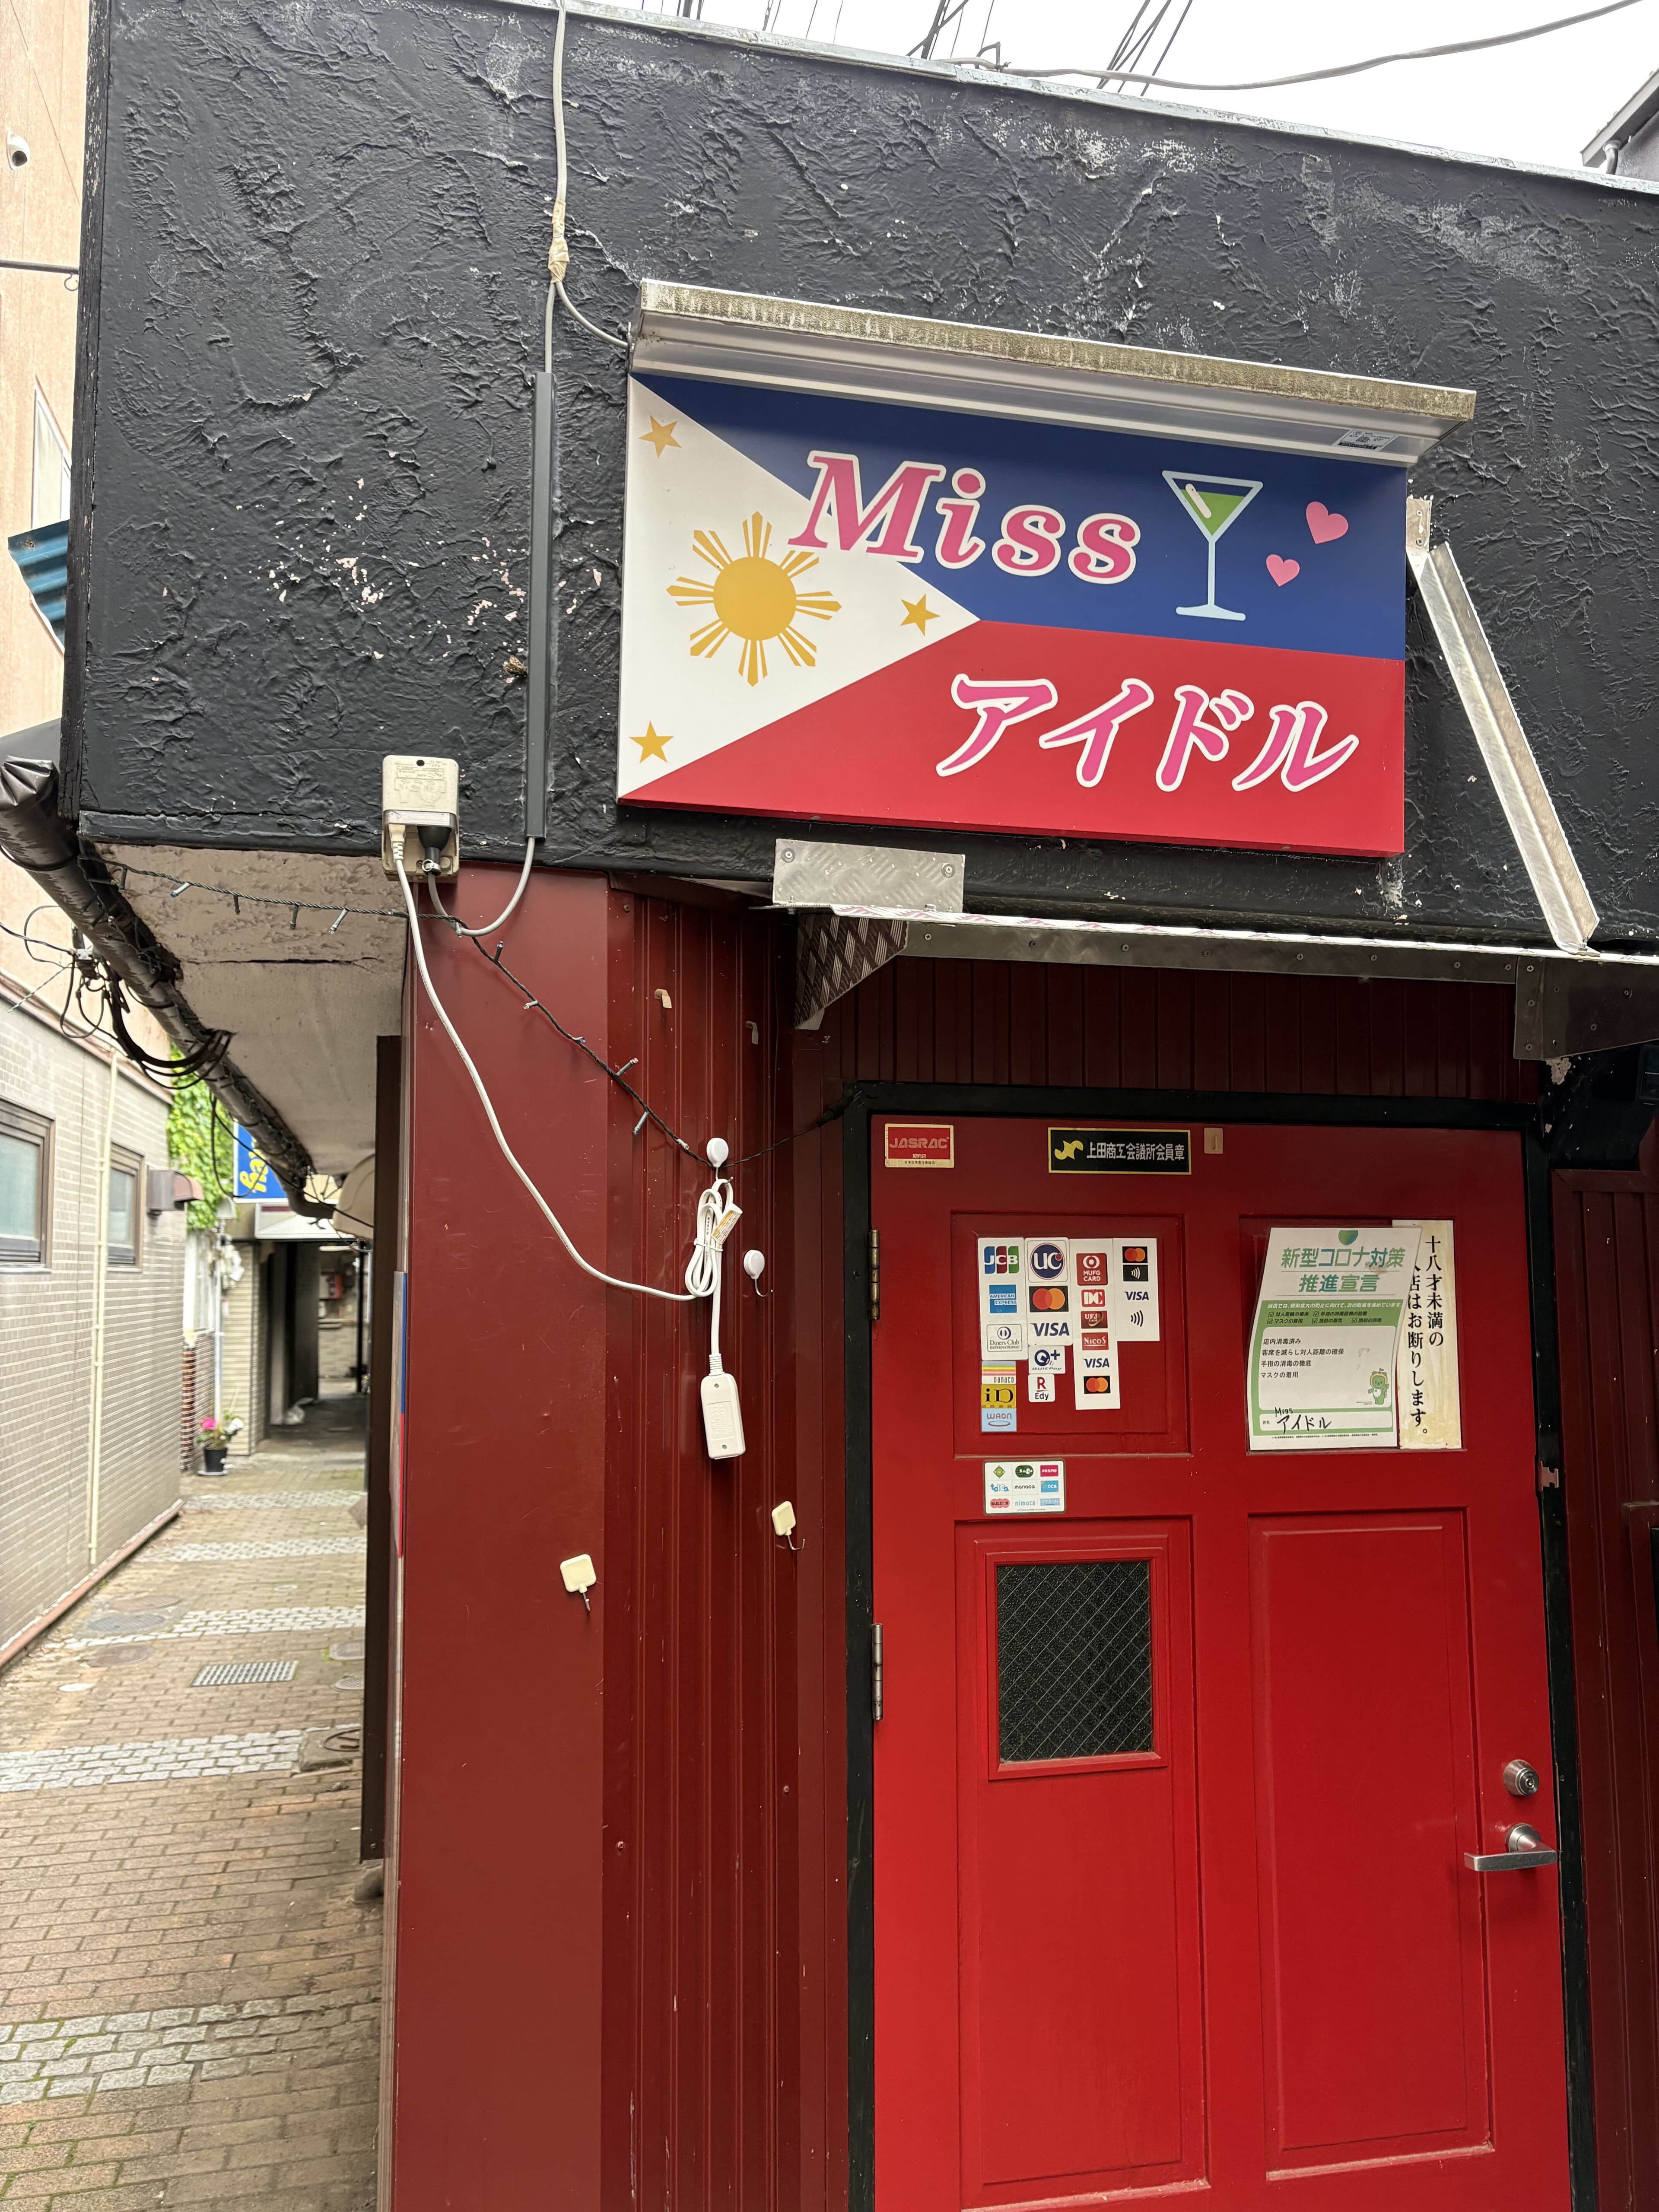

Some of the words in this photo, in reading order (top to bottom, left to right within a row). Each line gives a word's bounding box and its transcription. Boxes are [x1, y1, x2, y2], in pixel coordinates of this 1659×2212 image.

[785, 450, 1141, 584] Miss
[936, 674, 1358, 792] アイドル
[889, 1138, 948, 1149] JASRAC
[1087, 1141, 1185, 1161] 上田商工会議所会員章
[1281, 1246, 1406, 1268] 新型コロナ対策
[1299, 1274, 1380, 1293] 推進宣言
[1425, 1236, 1443, 1346] 十八才未満の
[1084, 1292, 1103, 1305] DC
[1124, 1291, 1149, 1300] VISA
[1030, 1322, 1070, 1337] VISA
[1408, 1265, 1427, 1433] 店はお断りします。
[1083, 1358, 1110, 1368] VISA
[1037, 1377, 1046, 1389] R
[985, 1388, 1014, 1403] iD
[1276, 1414, 1332, 1434] アイドル
